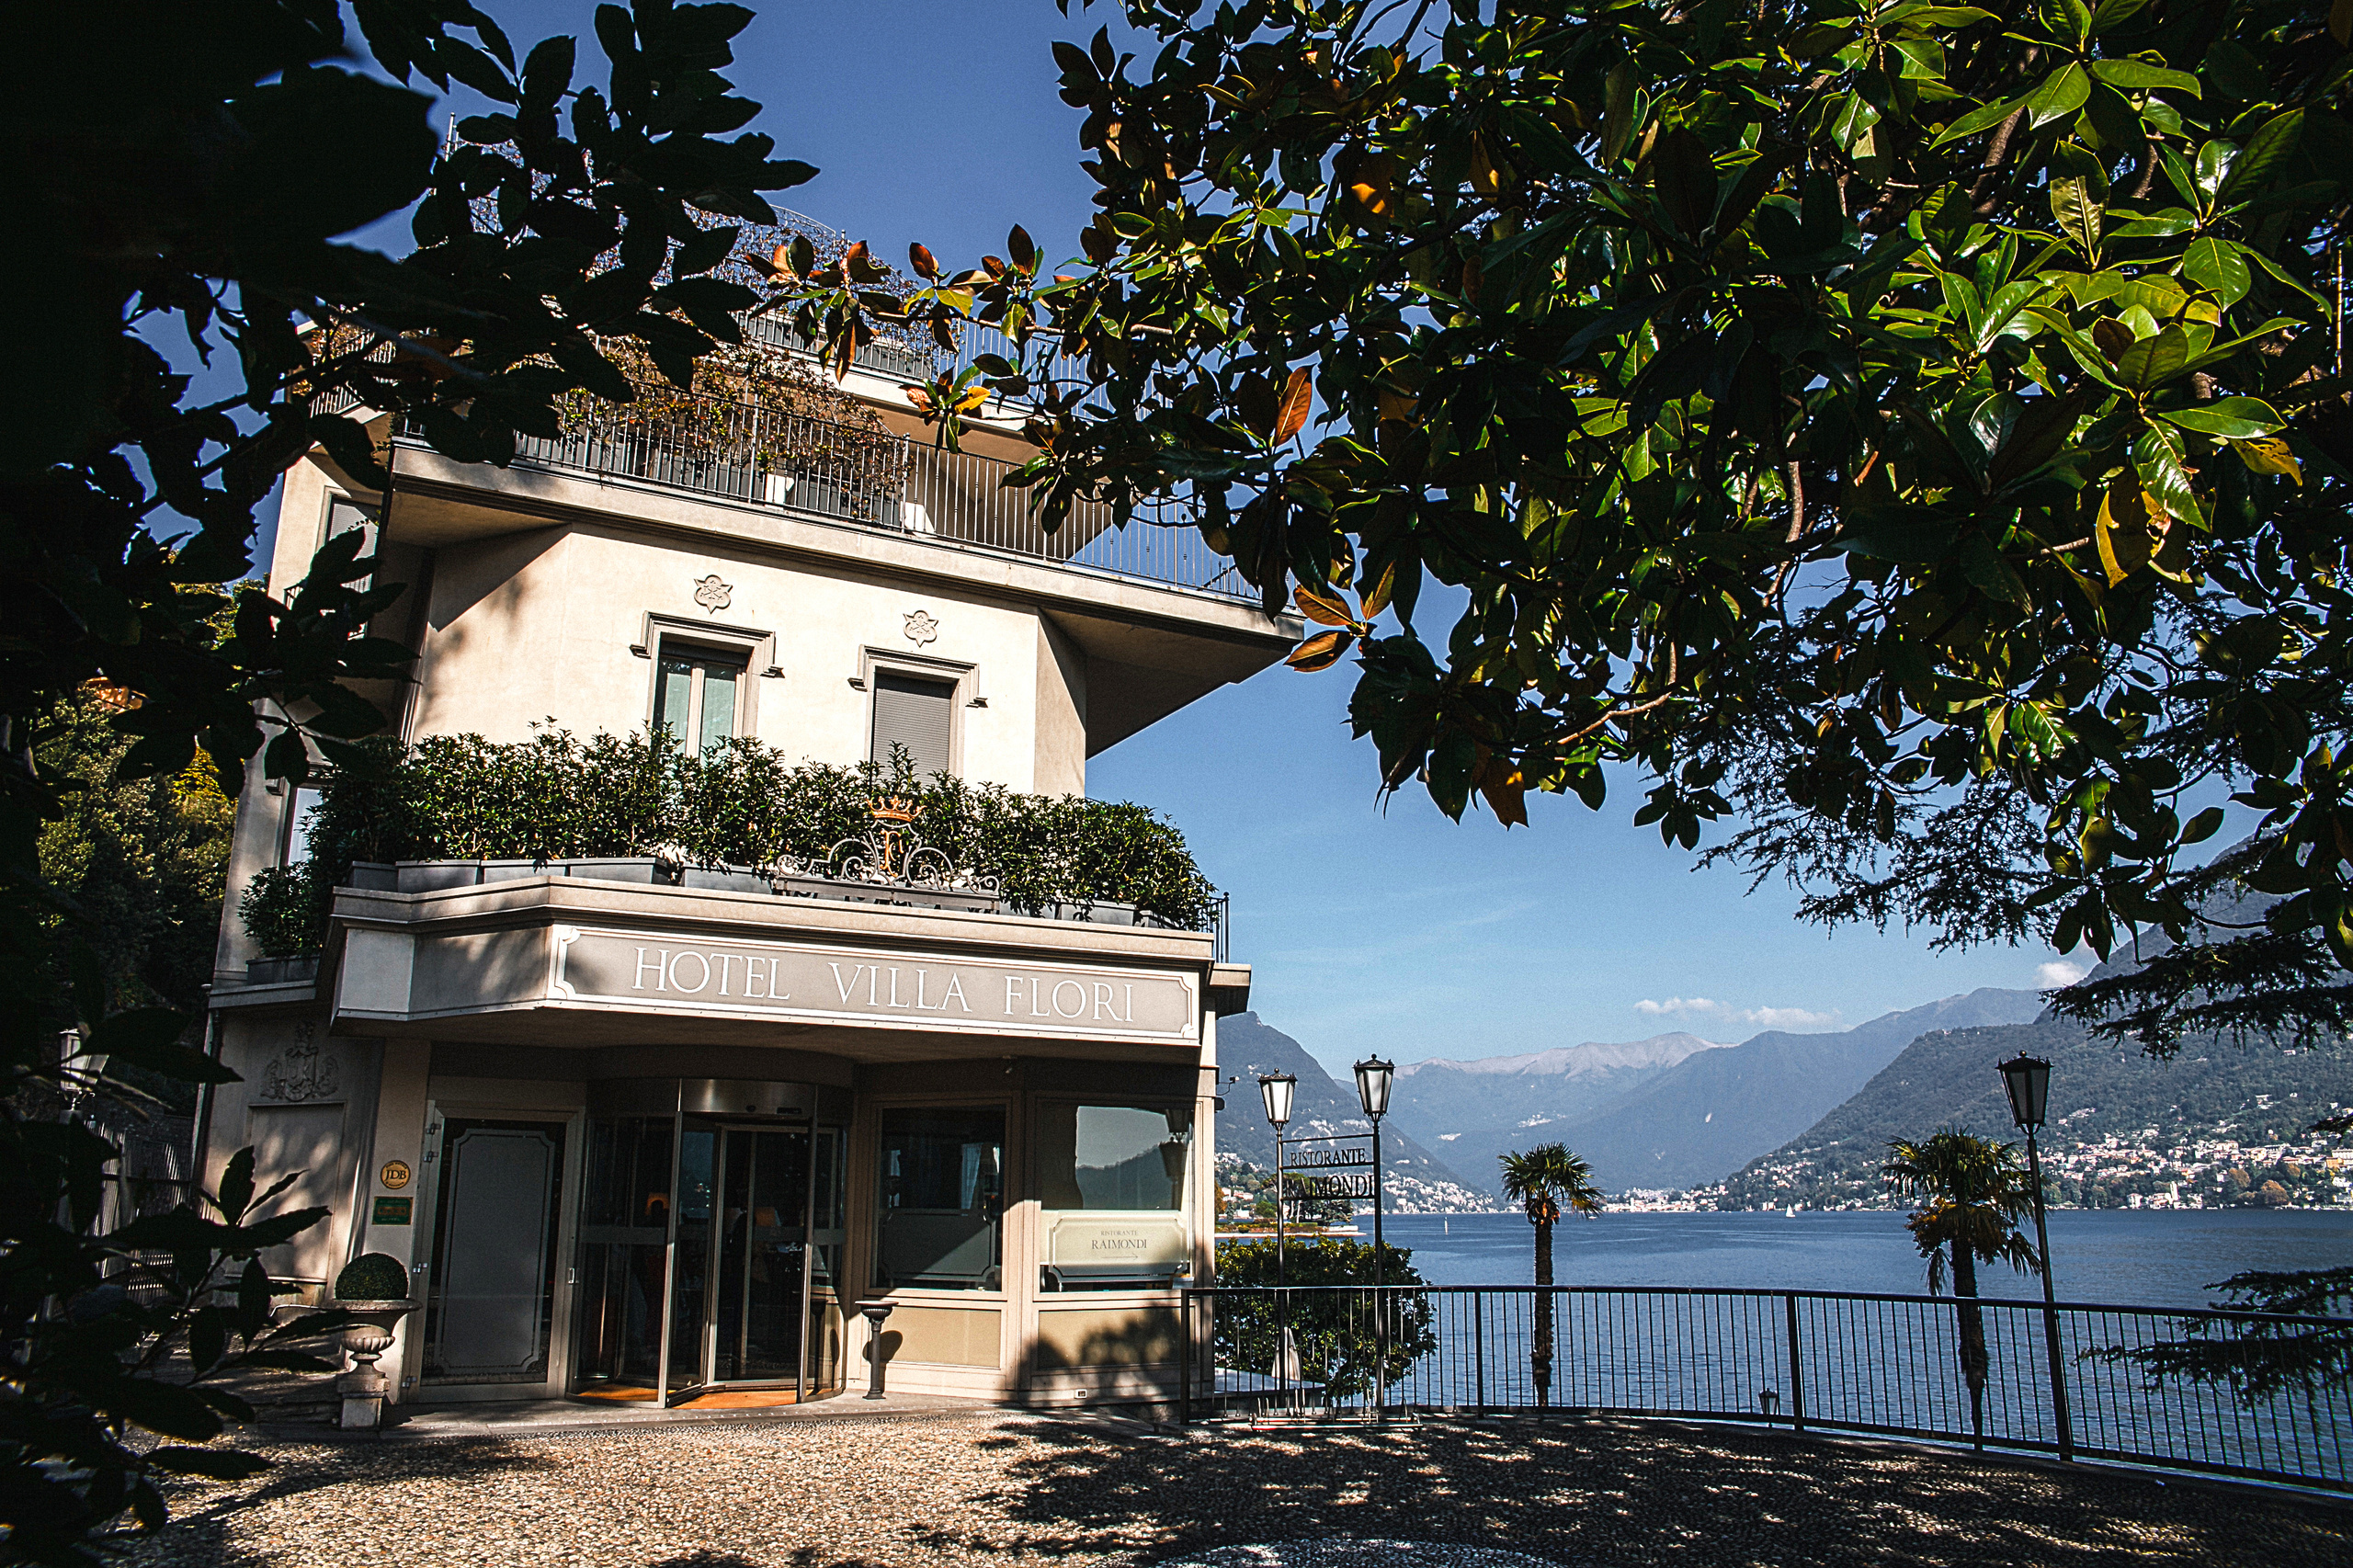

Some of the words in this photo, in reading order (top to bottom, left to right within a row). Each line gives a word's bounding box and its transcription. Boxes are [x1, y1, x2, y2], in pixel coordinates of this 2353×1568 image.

[631, 947, 790, 1000] HOTEL
[827, 961, 972, 1013] VILLA
[1003, 975, 1134, 1023] FLORI
[1290, 1148, 1366, 1165] RISTORANTE
[384, 1169, 406, 1181] JDB
[1284, 1176, 1375, 1197] RAIMONDI
[1091, 1239, 1147, 1250] RAIMONDI
